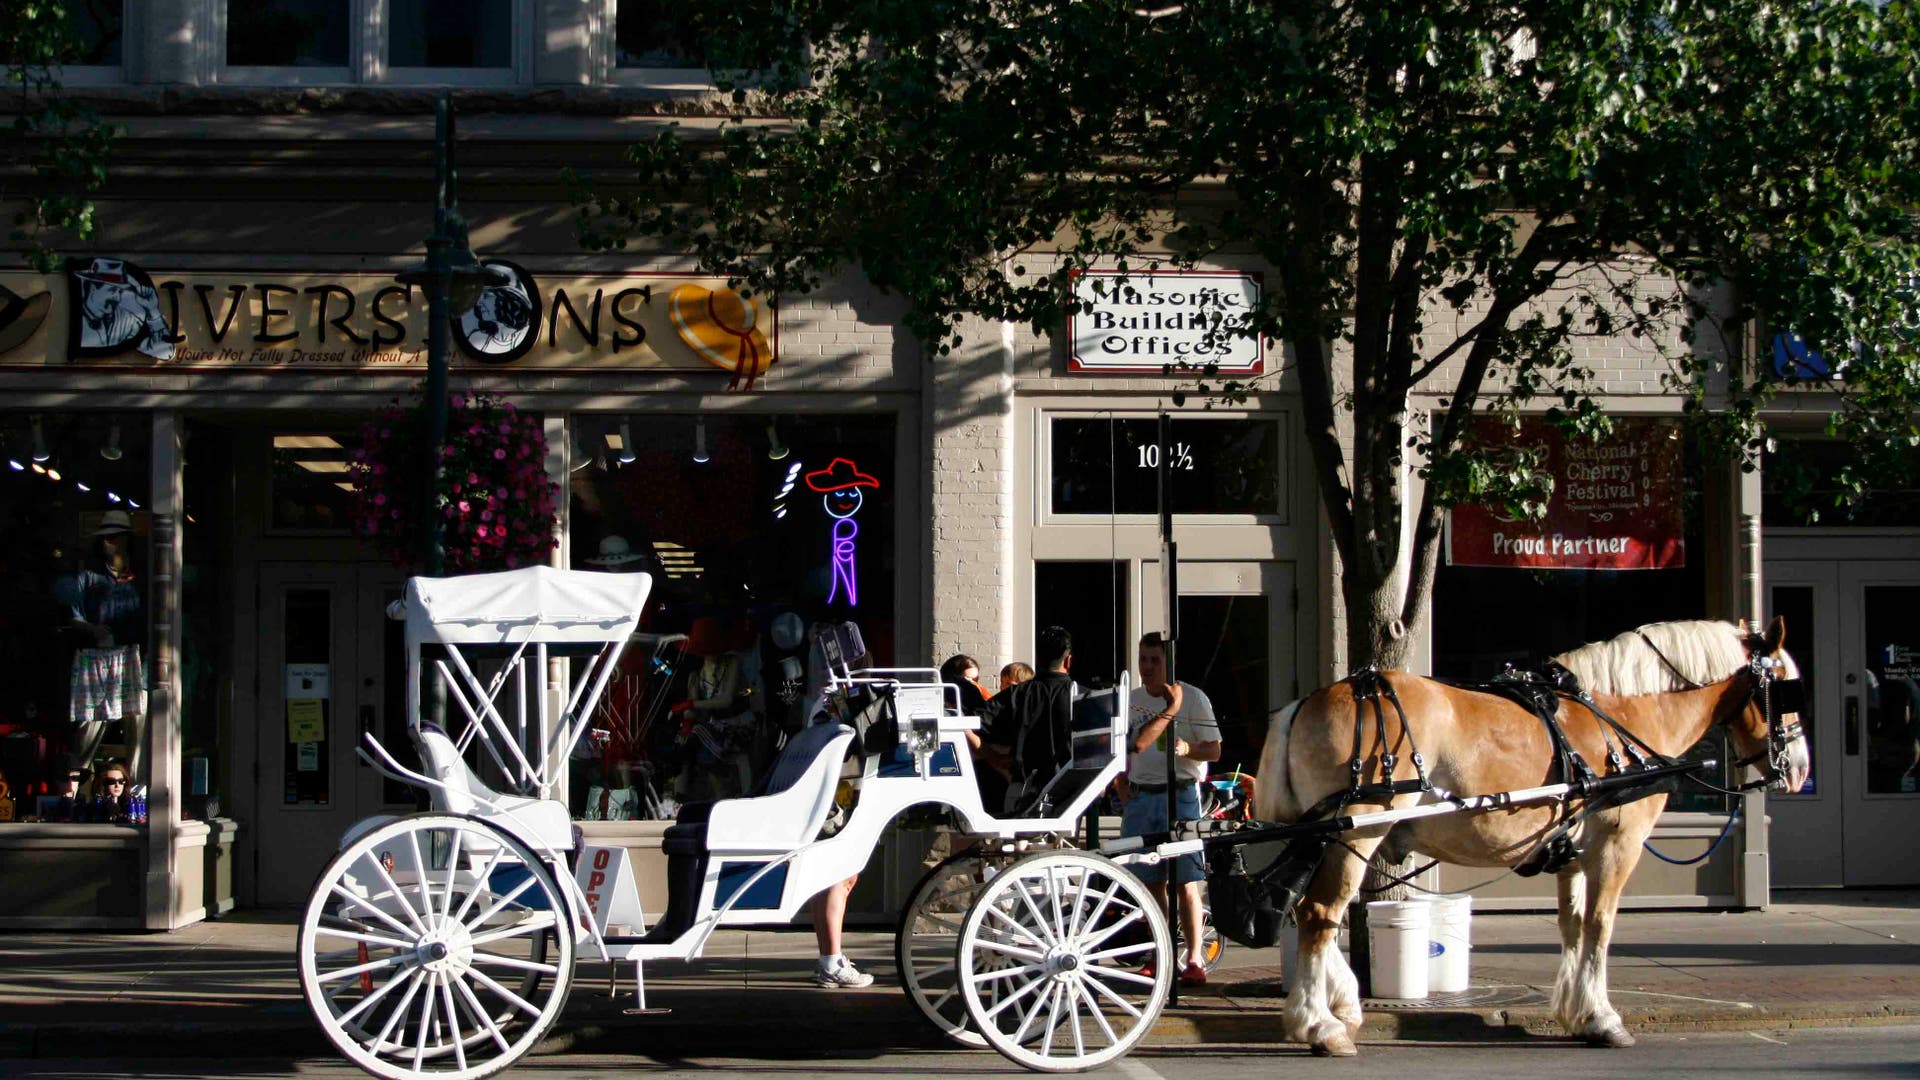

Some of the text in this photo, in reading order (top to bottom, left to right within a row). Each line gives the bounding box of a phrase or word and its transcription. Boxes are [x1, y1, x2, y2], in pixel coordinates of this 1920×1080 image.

[66, 257, 651, 363] DIVERSONS
[1101, 335, 1232, 355] Offices
[219, 348, 242, 361] Not
[249, 348, 284, 365] Fully
[288, 348, 345, 363] Dressed
[351, 348, 402, 363] Without
[1565, 442, 1636, 460] National
[1566, 462, 1632, 482] Cherry
[1640, 441, 1650, 507] 2009
[1566, 482, 1636, 500] Festival
[1493, 533, 1630, 555] Proud Partner
